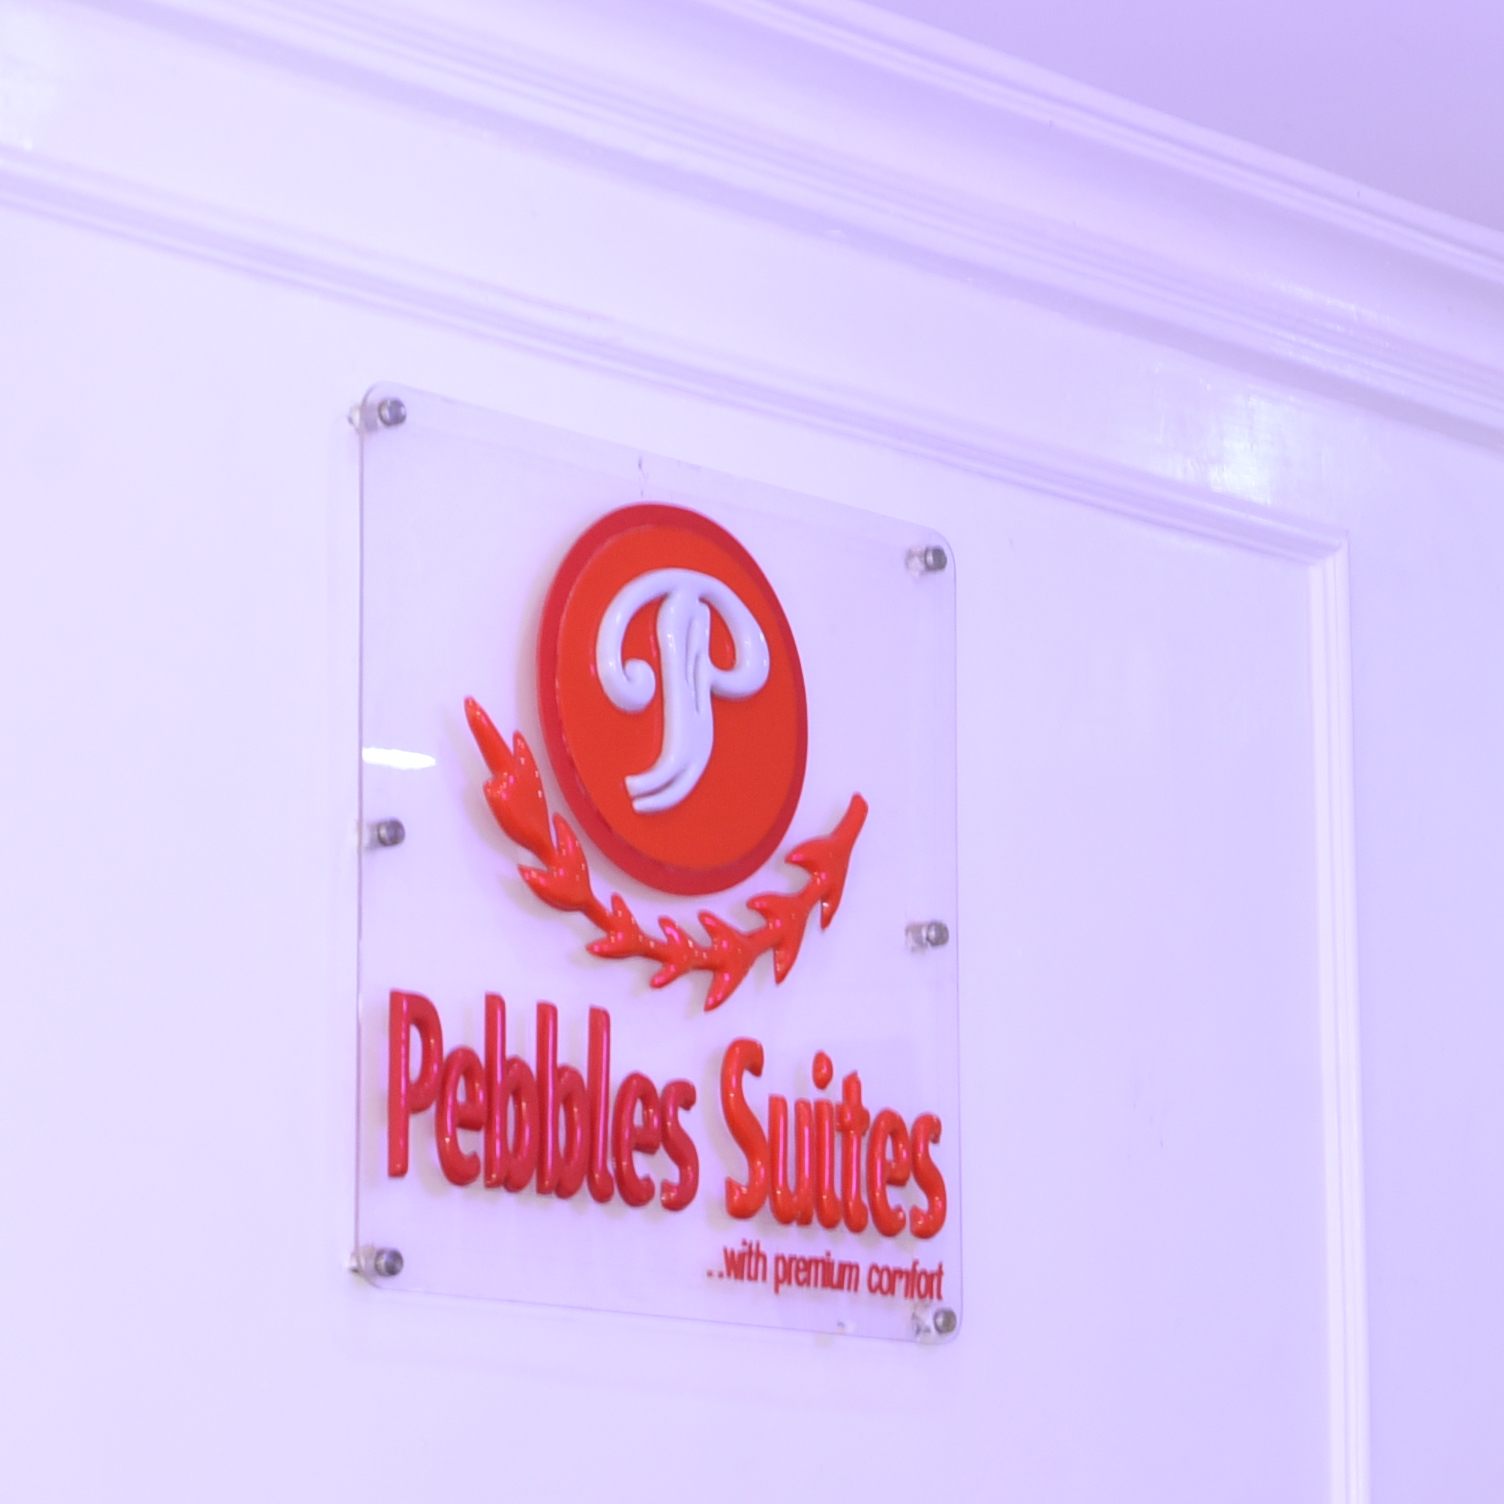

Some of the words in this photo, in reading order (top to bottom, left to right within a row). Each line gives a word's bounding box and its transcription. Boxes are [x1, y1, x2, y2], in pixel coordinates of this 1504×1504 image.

[386, 988, 699, 1213] Pebbles
[719, 1036, 948, 1240] Suites
[773, 1251, 861, 1295] premium
[866, 1260, 944, 1302] comfort
